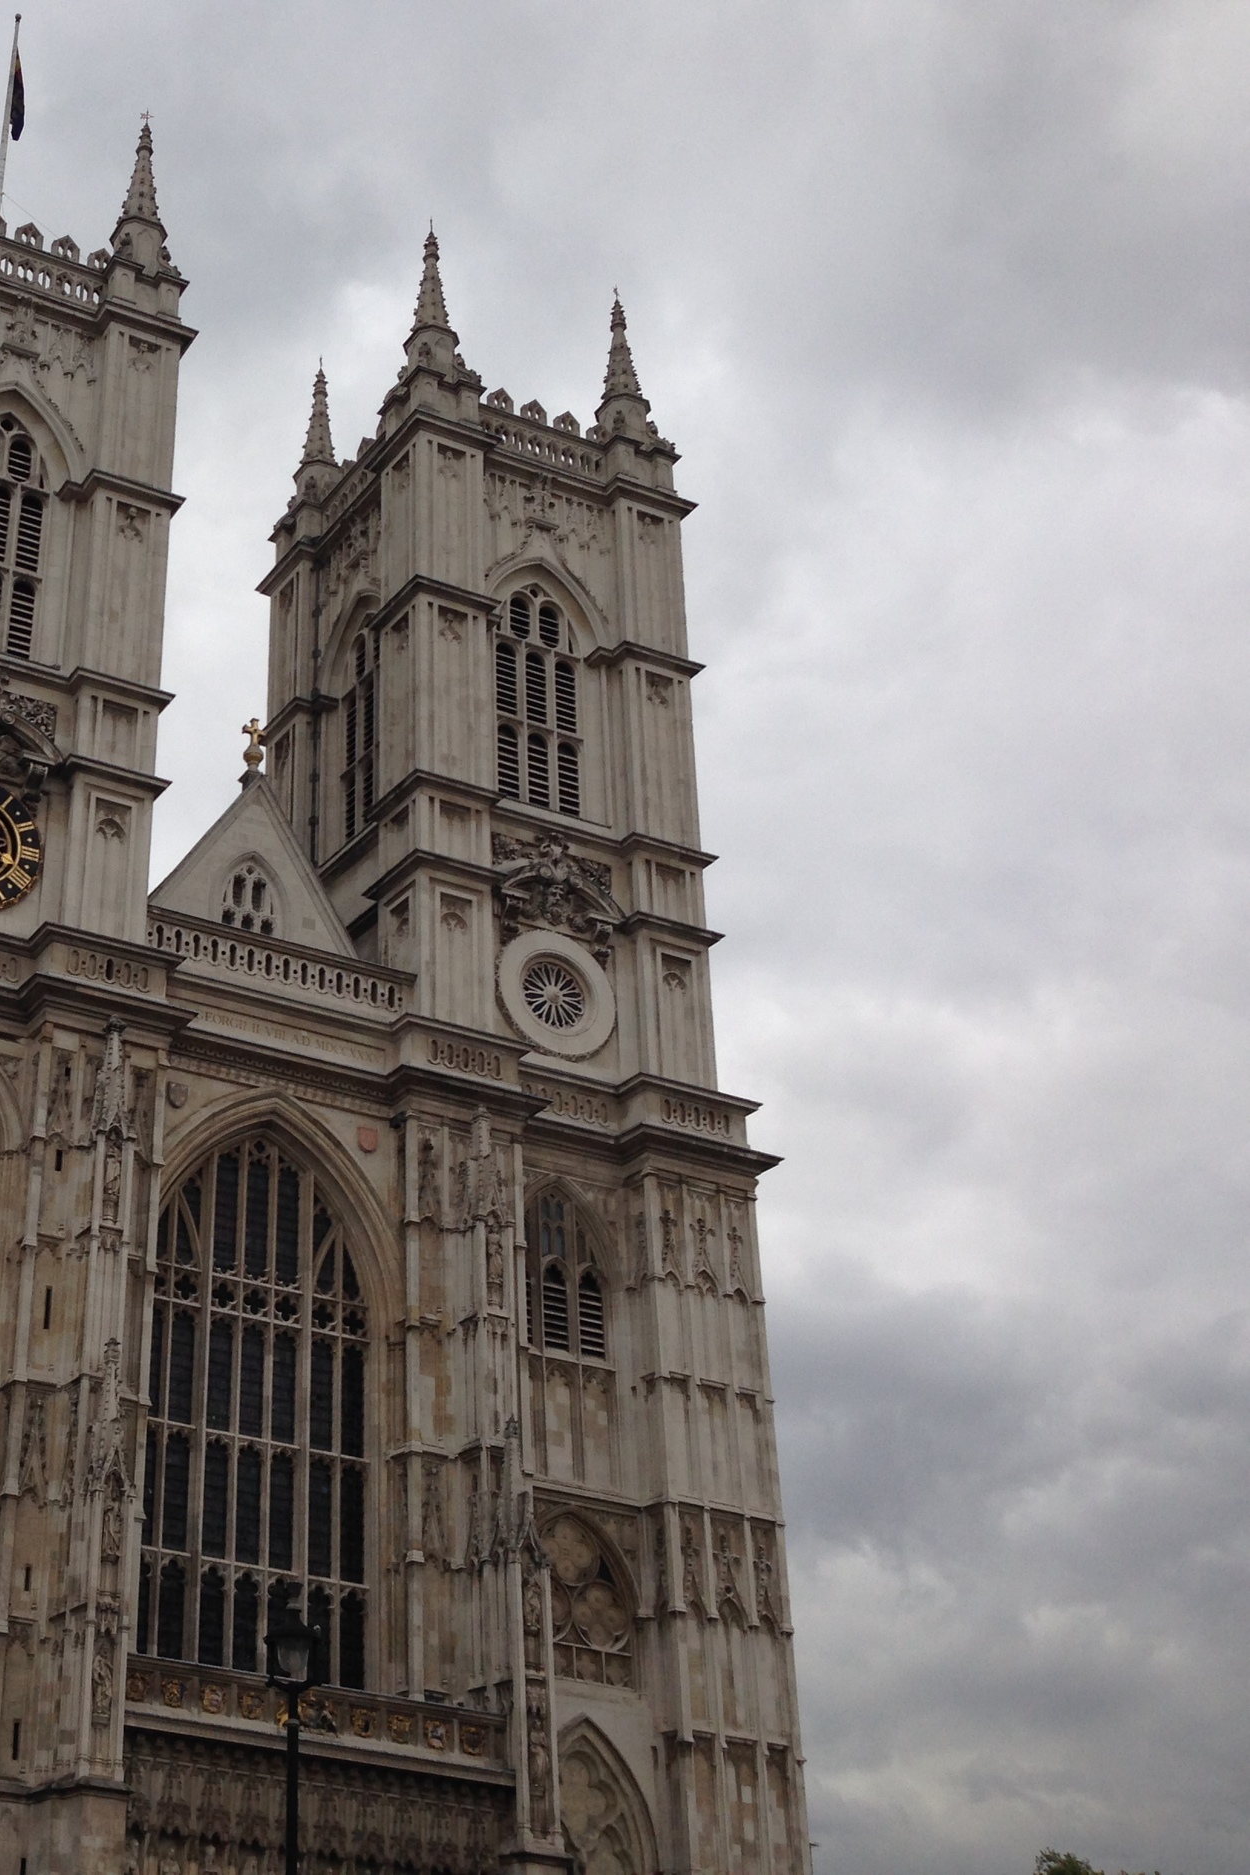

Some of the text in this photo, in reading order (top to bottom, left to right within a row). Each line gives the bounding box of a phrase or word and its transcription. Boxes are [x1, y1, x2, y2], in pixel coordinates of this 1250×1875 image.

[1, 795, 14, 808] I
[18, 821, 35, 832] II
[21, 845, 40, 862] III
[8, 866, 32, 890] IIII
[252, 1023, 260, 1034] II
